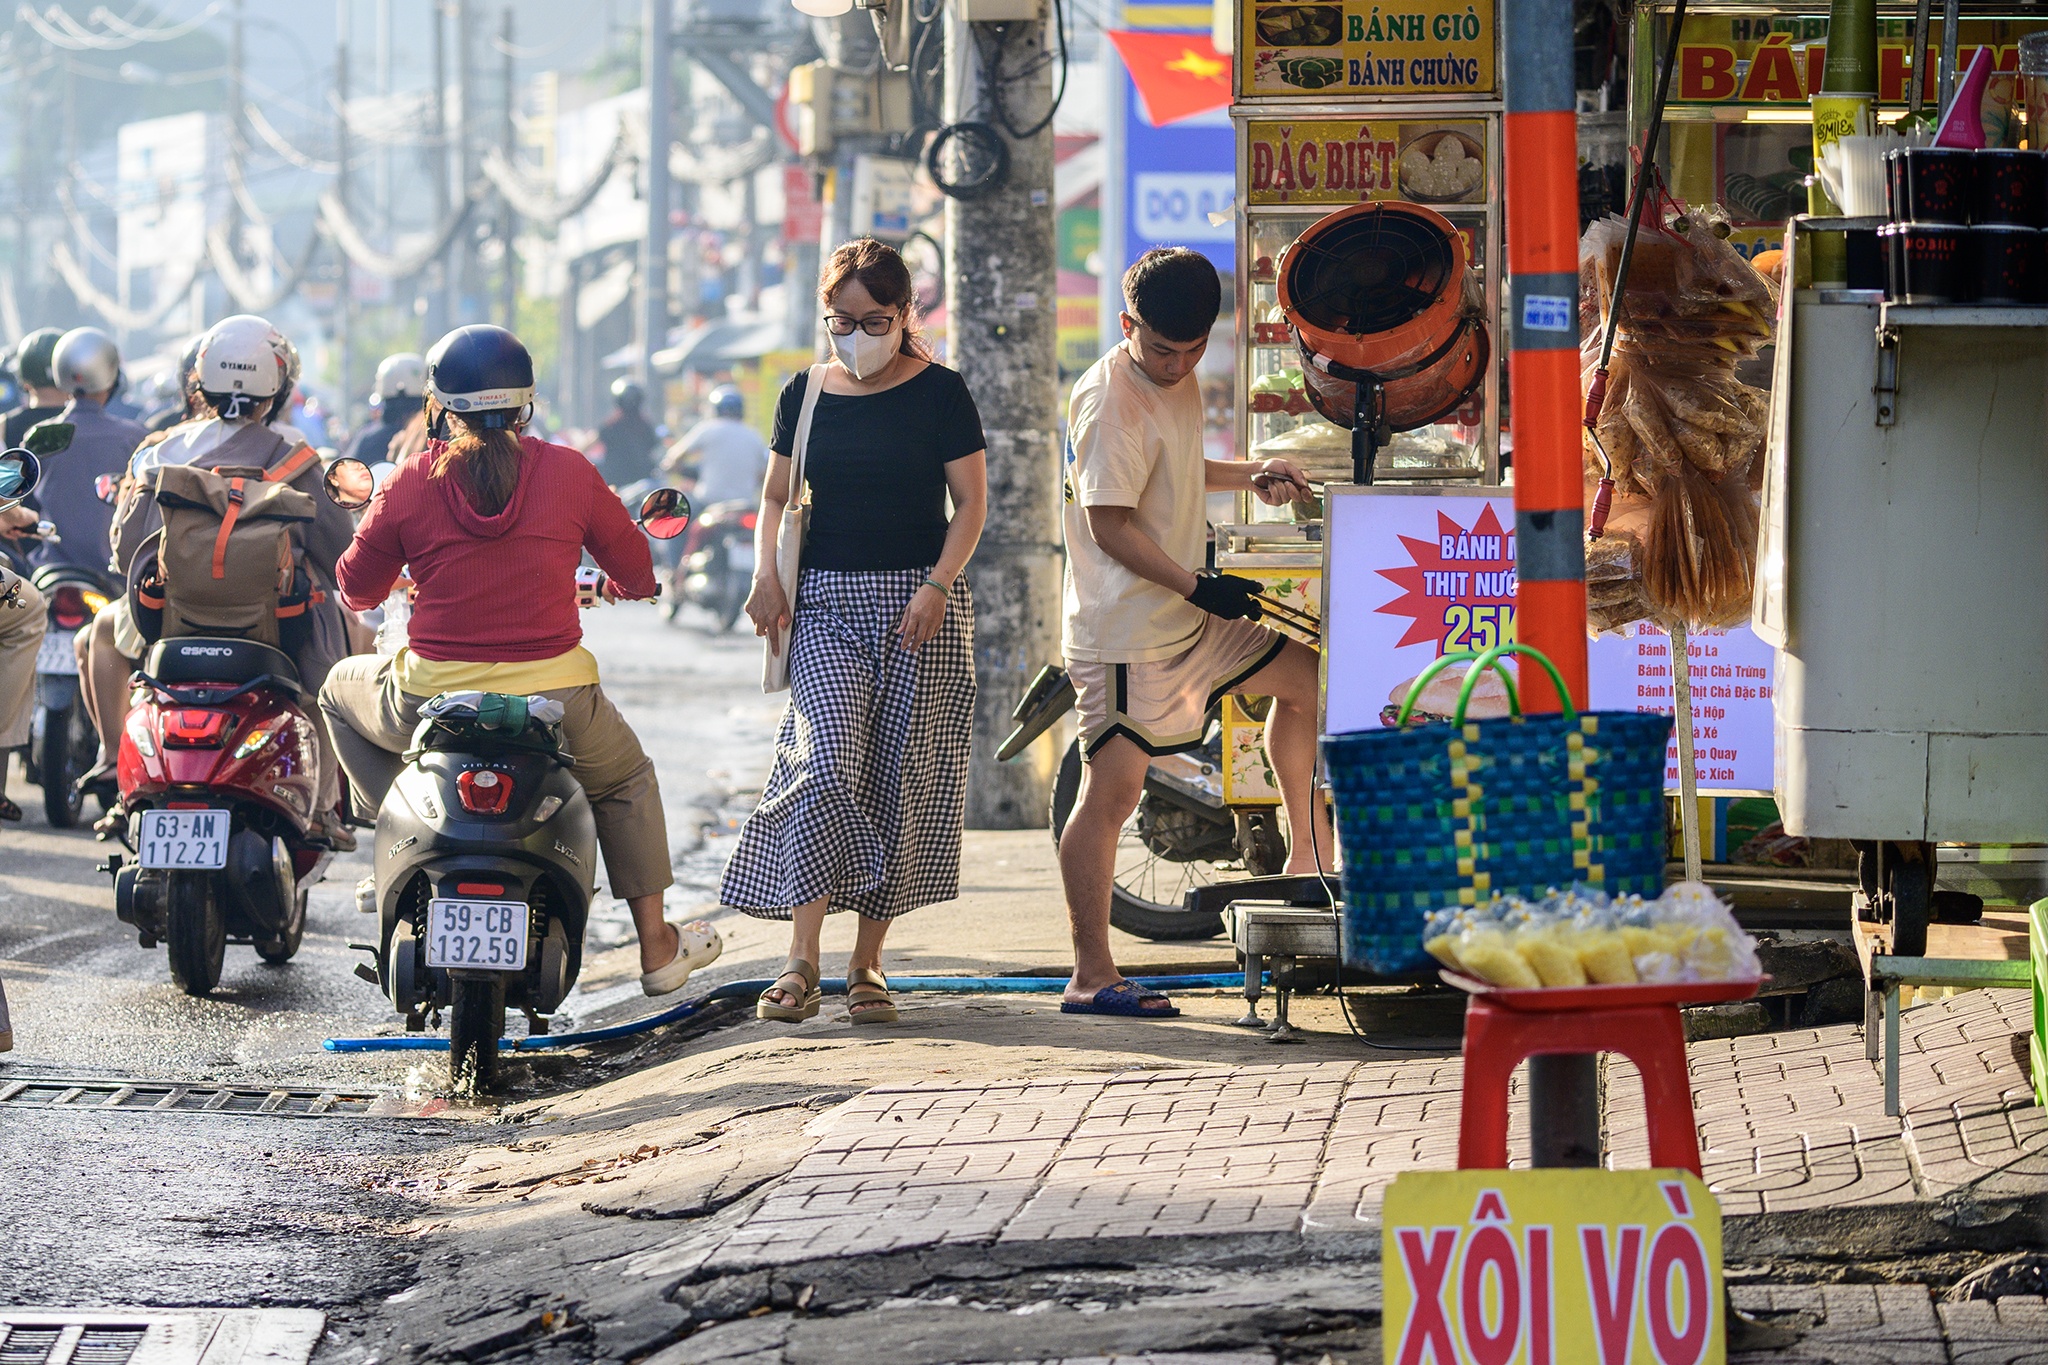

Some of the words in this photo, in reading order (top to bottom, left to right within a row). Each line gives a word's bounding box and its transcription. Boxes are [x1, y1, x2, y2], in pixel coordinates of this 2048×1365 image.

[1347, 7, 1426, 42] BÁNH
[1432, 6, 1481, 42] GIÒ
[1347, 51, 1405, 86] BÁNH
[1410, 52, 1479, 86] CHƯNG
[1679, 34, 1938, 101] BÁH
[1252, 126, 1318, 200] ĐẶC
[1325, 126, 1396, 200] BIỆT
[228, 362, 257, 371] YAMAHA
[1440, 529, 1501, 560] BÁNH
[1422, 570, 1470, 602] THỊT
[1474, 566, 1518, 598] NƯỚ
[1638, 643, 1667, 657] Bánh
[1705, 645, 1718, 657] La
[1637, 664, 1666, 677] Bánh
[1711, 663, 1732, 677] Chả
[1735, 665, 1766, 679] Trứng
[1637, 684, 1666, 697] Bánh
[1710, 683, 1731, 698] Chả
[1734, 685, 1756, 701] Đặc
[1759, 686, 1773, 699] Bi
[1703, 705, 1725, 721] Hộp
[1703, 726, 1718, 739] Xé
[1693, 748, 1706, 759] eo
[1709, 746, 1738, 761] Quay
[1694, 767, 1706, 780] úc
[1709, 767, 1735, 780] Xích
[155, 814, 215, 838] 63-AN
[147, 841, 221, 865] 112.21
[443, 904, 513, 934] 59-CB
[438, 935, 518, 965] 132.59
[1394, 1190, 1555, 1365] XÔI
[1578, 1181, 1712, 1365] VÒ
